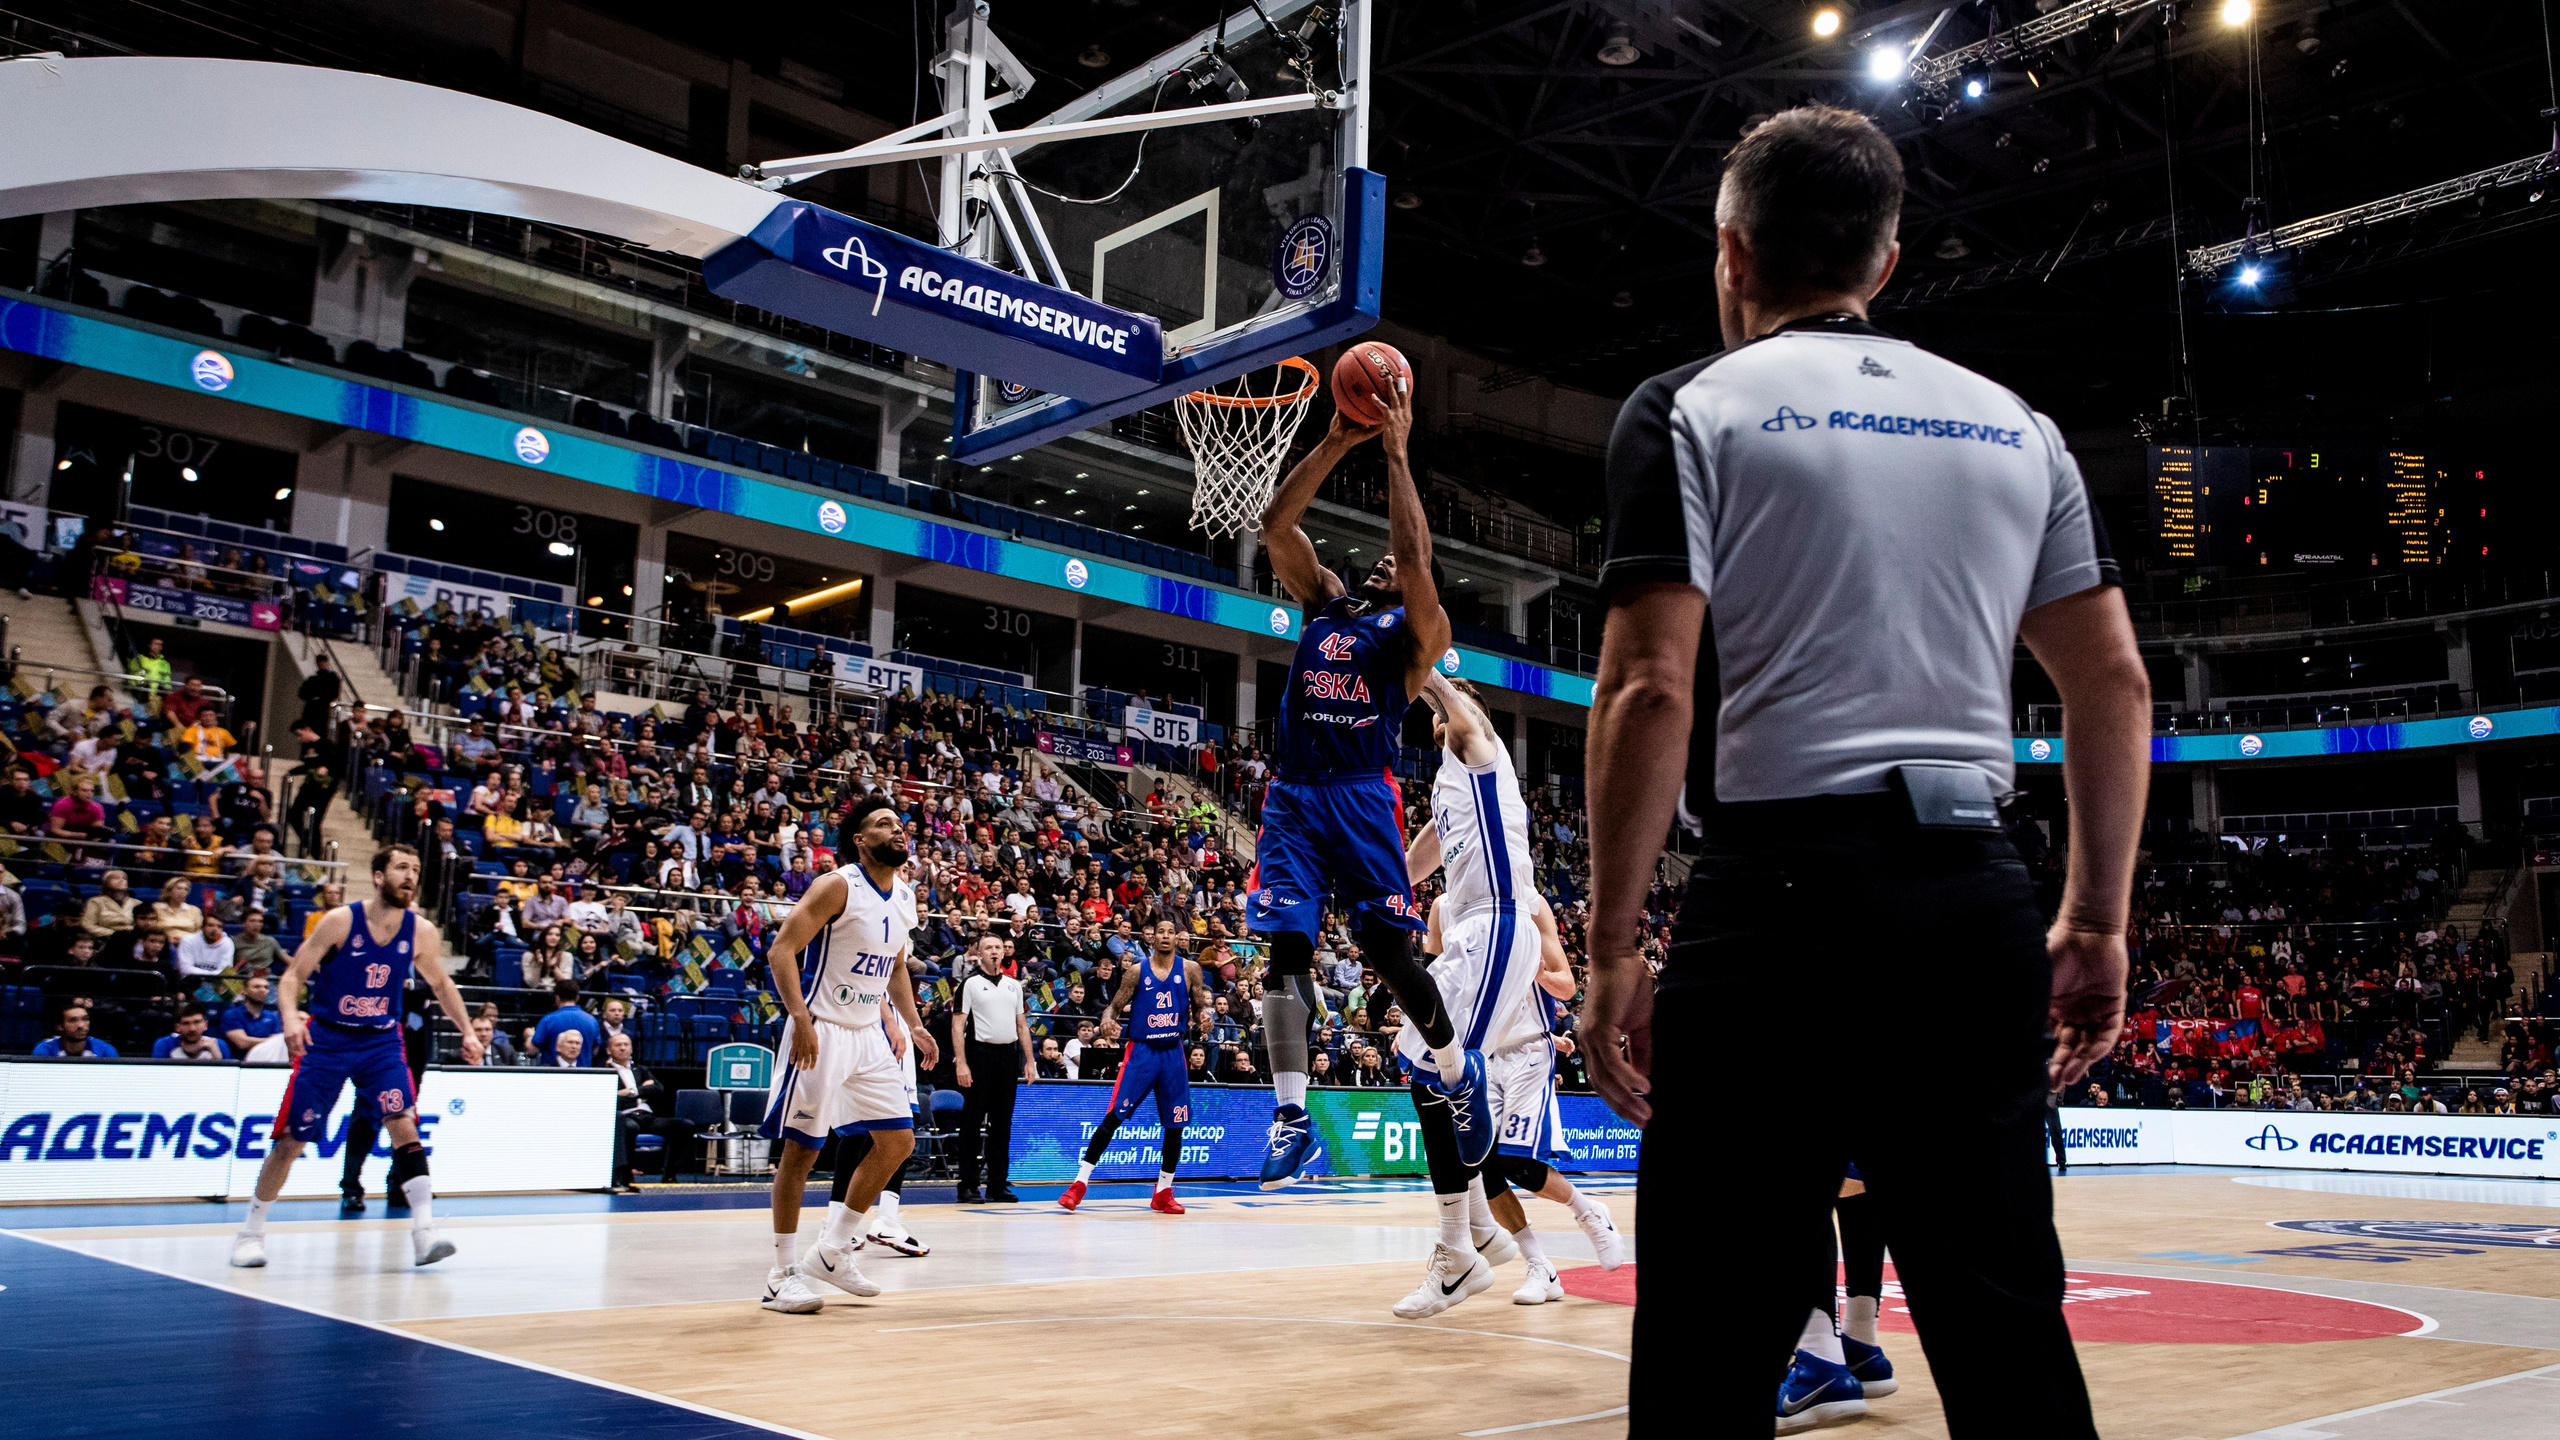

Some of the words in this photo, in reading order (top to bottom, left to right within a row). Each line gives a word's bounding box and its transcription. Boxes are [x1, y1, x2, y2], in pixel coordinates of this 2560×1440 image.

[1286, 287, 1302, 296] FINAL
[1303, 276, 1320, 293] FOUR
[138, 426, 220, 467] 307
[513, 505, 577, 543] 308
[719, 548, 775, 582] 309
[129, 591, 164, 610] 201
[193, 603, 228, 621] 202
[984, 605, 1030, 638] 310
[1162, 643, 1201, 673] 311
[1319, 632, 1356, 660] 42
[1303, 670, 1370, 703] CSKA
[1154, 717, 1189, 742] ВТБ
[1303, 711, 1355, 724] AOFLOT
[1087, 748, 1105, 761] 203
[882, 916, 889, 943] 1
[365, 963, 391, 989] 13
[339, 995, 389, 1017] CSKA
[1156, 991, 1173, 1009] 21
[378, 1088, 404, 1113] 13
[1173, 1105, 1188, 1123] 21
[1080, 1121, 1162, 1140] Тильный
[1181, 1124, 1225, 1143] онсор
[1505, 1114, 1531, 1140] 31
[1562, 1126, 1604, 1143] тульный
[1384, 1121, 1428, 1162] ВТ
[1591, 1145, 1614, 1160] Лиги
[1616, 1145, 1637, 1159] ВТБ
[1078, 1146, 1137, 1166] Еиной
[1180, 1146, 1210, 1162] ВТБ
